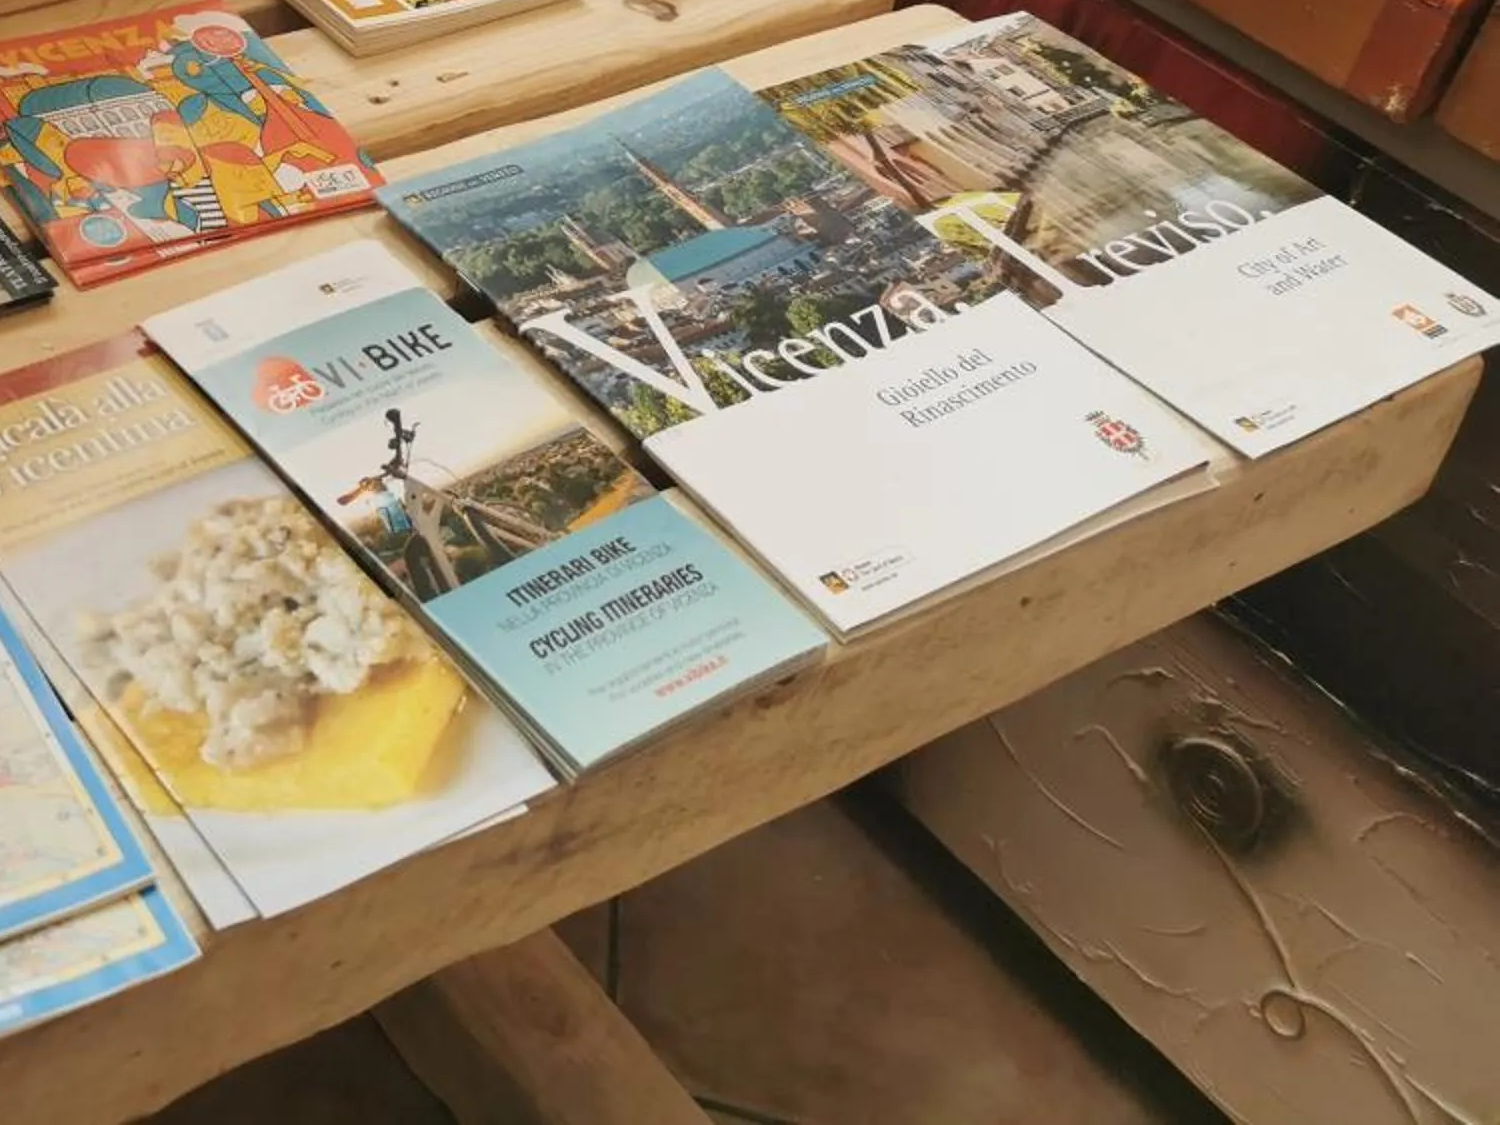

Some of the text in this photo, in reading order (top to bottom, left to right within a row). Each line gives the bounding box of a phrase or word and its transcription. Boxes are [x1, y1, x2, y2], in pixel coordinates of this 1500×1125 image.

[1237, 236, 1332, 280] City of Art
[1267, 252, 1347, 296] and Water
[92, 375, 168, 422] alla
[877, 347, 994, 408] Gioiello del
[900, 360, 1037, 427] Rinascimento
[506, 537, 637, 607] ITINERARI BIKE
[529, 611, 605, 659] CYCLING
[600, 563, 704, 623] ITINERARIES
